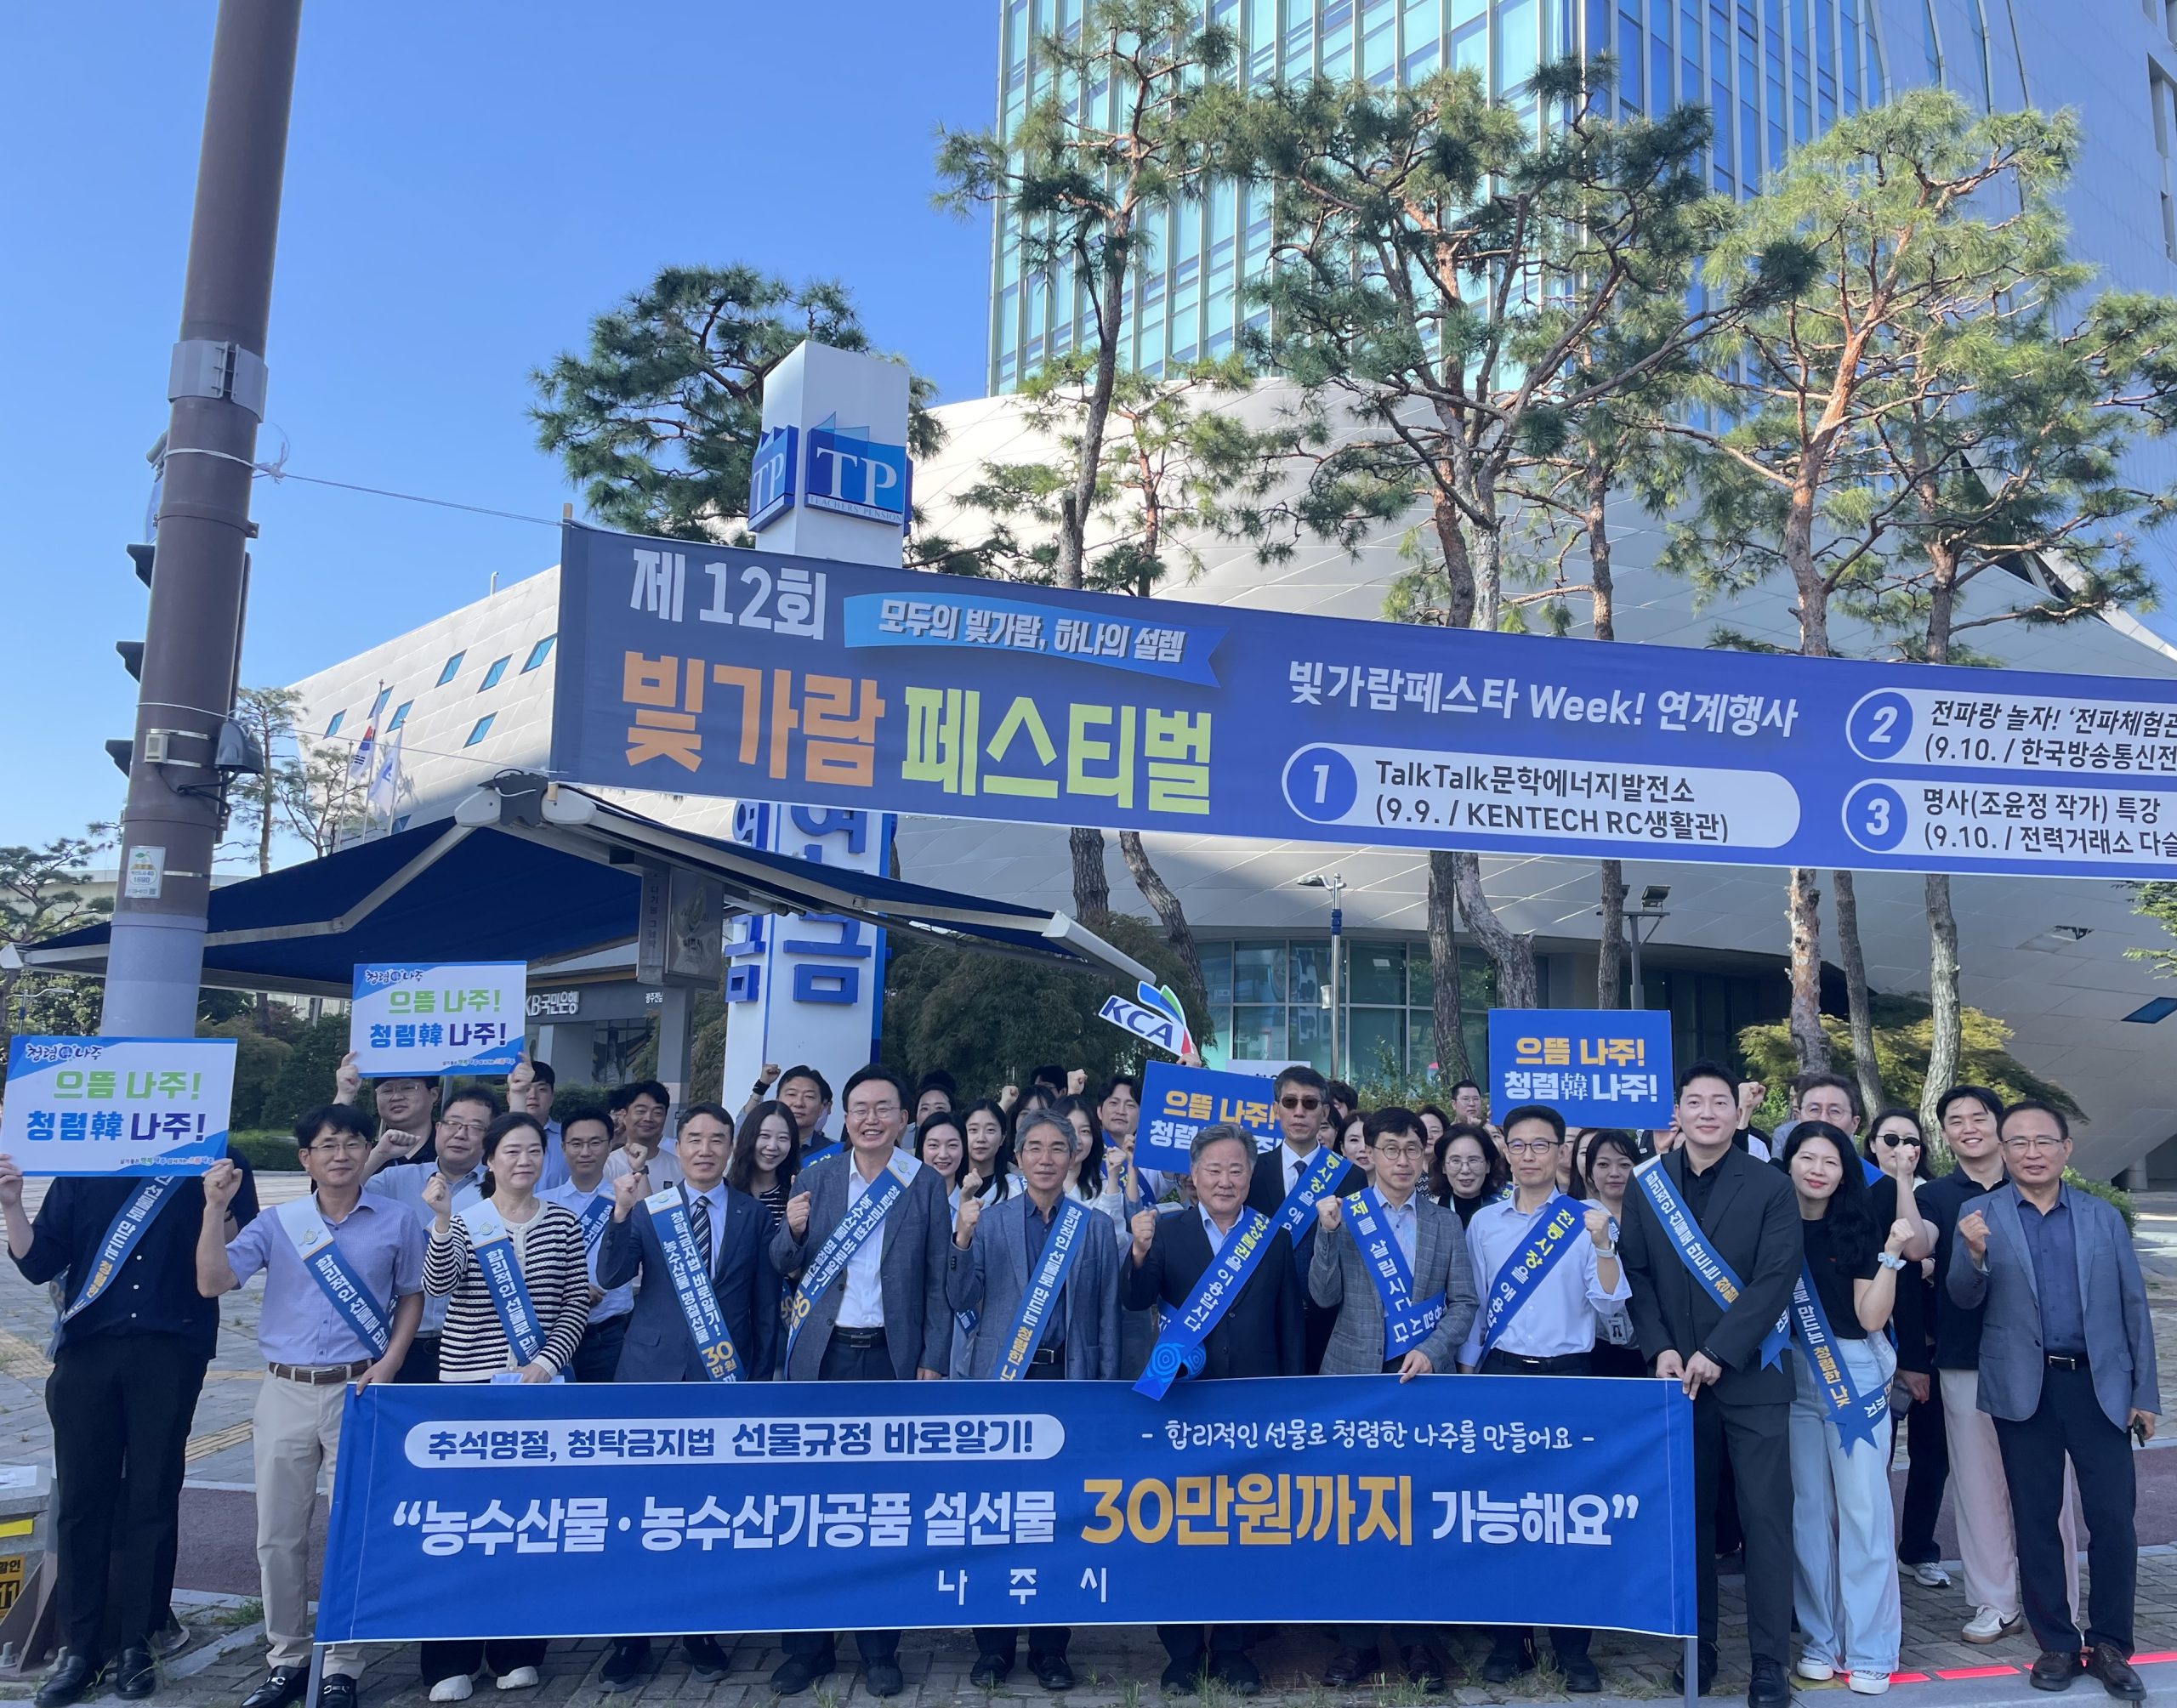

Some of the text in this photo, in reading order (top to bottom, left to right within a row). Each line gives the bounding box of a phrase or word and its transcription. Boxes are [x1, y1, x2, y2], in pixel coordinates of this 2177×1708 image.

[753, 452, 784, 515] TP
[816, 447, 897, 508] TP
[863, 508, 903, 524] PENSION
[630, 548, 827, 641] 제 12회
[878, 599, 1186, 663] 모두의 빛가람, 하나의 설렘
[1288, 661, 1799, 738] 빛가람페스타 Week! 연계행사
[1931, 700, 2002, 729] 전파랑
[2007, 705, 2061, 732] 놀자!
[622, 650, 1212, 815] 빛가람 페스티벌
[1867, 706, 1898, 744] 2
[1925, 733, 1996, 762] (9.10.
[1312, 764, 1330, 803] 1
[1375, 759, 1695, 803] TalkTalk문학에너지발전소
[1376, 794, 1440, 826] (9.9.
[1467, 803, 1599, 833] KENTECH
[1606, 809, 1728, 843] RC생활관)
[1866, 797, 1890, 836] 3
[1923, 788, 2161, 825] 명사(조윤정 작가) 특강
[1924, 821, 1997, 851] (9.10.
[2020, 826, 2134, 855] 전력거래소
[389, 989, 502, 1014] 으뜸 나주!
[1101, 996, 1174, 1049] KCA
[370, 1022, 507, 1048] 청렴韓 나주!
[1515, 1037, 1646, 1067] 으뜸 나주!
[54, 1070, 202, 1100] 으뜸 나주!
[1503, 1070, 1658, 1103] 청렴韓 나주!
[27, 1110, 207, 1142] 청렴韓 나주!
[1163, 1090, 1276, 1130] 으뜸 나주!
[1150, 1120, 1201, 1149] 청렴
[125, 1185, 164, 1223] 선물로
[833, 1194, 874, 1240] 농수산물
[104, 1220, 137, 1261] 만드는
[810, 1185, 901, 1296] 청탁금지법 바로알기!
[1054, 1206, 1083, 1251] 합리적인
[1645, 1170, 1677, 1215] 합리적인
[1669, 1210, 1696, 1246] 선물로
[1685, 1242, 1722, 1281] 만드는
[1511, 1209, 1576, 1285] 전통시장을
[670, 1211, 721, 1336] 청탁금지법 바로알기!
[1037, 1250, 1065, 1288] 선물로
[1370, 1239, 1412, 1312] 살립시다
[315, 1253, 357, 1304] 합리적인
[350, 1297, 381, 1335] 선물로
[486, 1248, 518, 1299] 합리적인
[504, 1297, 531, 1337] 선물로
[663, 1240, 710, 1345] 농수산물 명절선물
[1022, 1286, 1050, 1326] 만드는
[1183, 1268, 1235, 1333] 이용합시다
[702, 1341, 734, 1368] 30
[1008, 1325, 1034, 1366] 청렴한
[1797, 1305, 1826, 1345] 만드는
[1813, 1345, 1842, 1385] 청렴한
[428, 1419, 1033, 1462] 추석명절, 청탁금지법 선물규정 바로알기!
[1164, 1419, 1259, 1451] 합리적인
[1265, 1418, 1327, 1451] 선물로
[1333, 1419, 1408, 1450] 청렴한
[1413, 1419, 1477, 1454] 나주를
[1483, 1421, 1573, 1454] 만들어요
[924, 1490, 1057, 1547] 설선물
[1080, 1473, 1413, 1546] 30만원까지
[1431, 1490, 1640, 1546] 가능해요”
